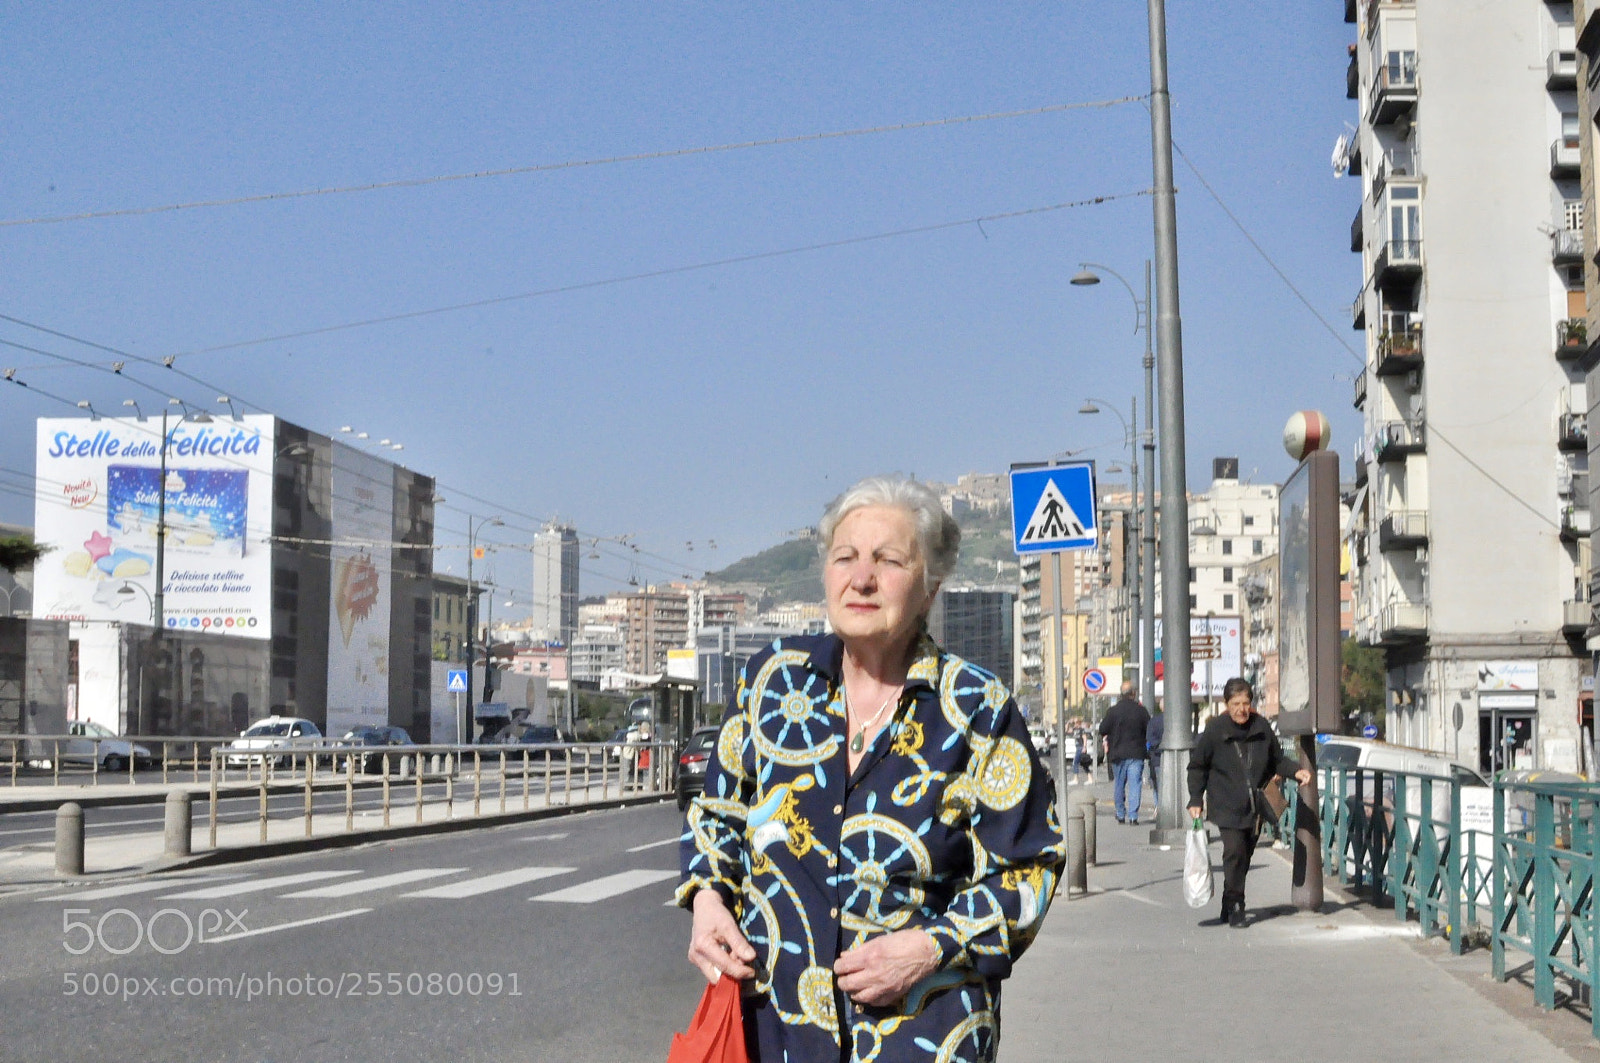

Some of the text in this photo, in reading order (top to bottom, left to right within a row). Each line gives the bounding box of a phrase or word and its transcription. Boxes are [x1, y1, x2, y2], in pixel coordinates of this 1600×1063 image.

[49, 427, 261, 458] Stelle della Felicità
[63, 479, 92, 495] Novità
[70, 493, 90, 507] New
[177, 492, 218, 508] Felicità
[170, 569, 245, 582] Deliziose stelline
[174, 583, 219, 593] cioccolato
[221, 582, 252, 593] bianco
